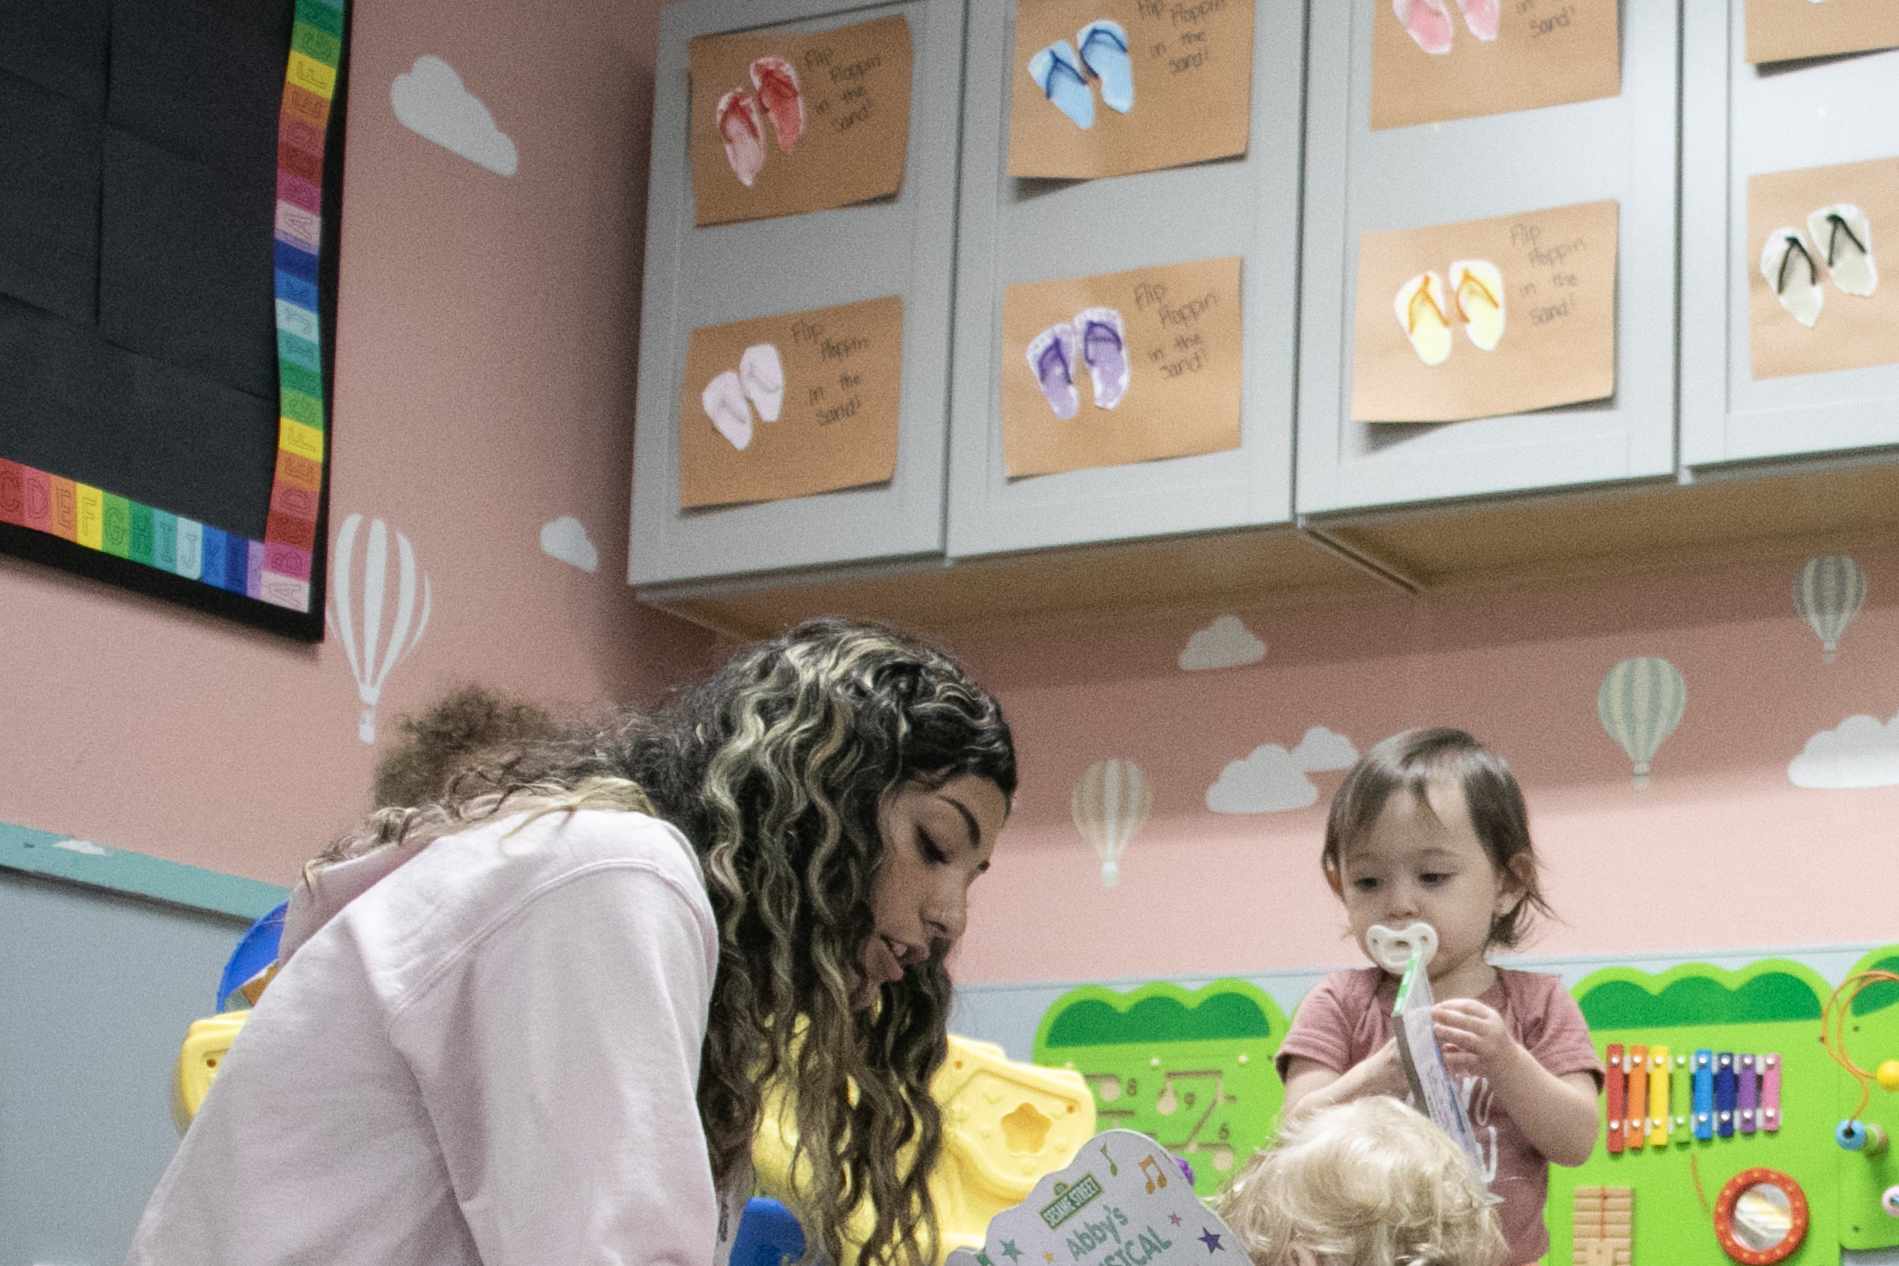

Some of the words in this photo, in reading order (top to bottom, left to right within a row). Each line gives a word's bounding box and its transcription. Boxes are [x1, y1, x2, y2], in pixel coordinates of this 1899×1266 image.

[1043, 1195, 1077, 1227] SESAME
[1067, 1177, 1100, 1206] STREET
[1066, 1204, 1128, 1262] Abby's
